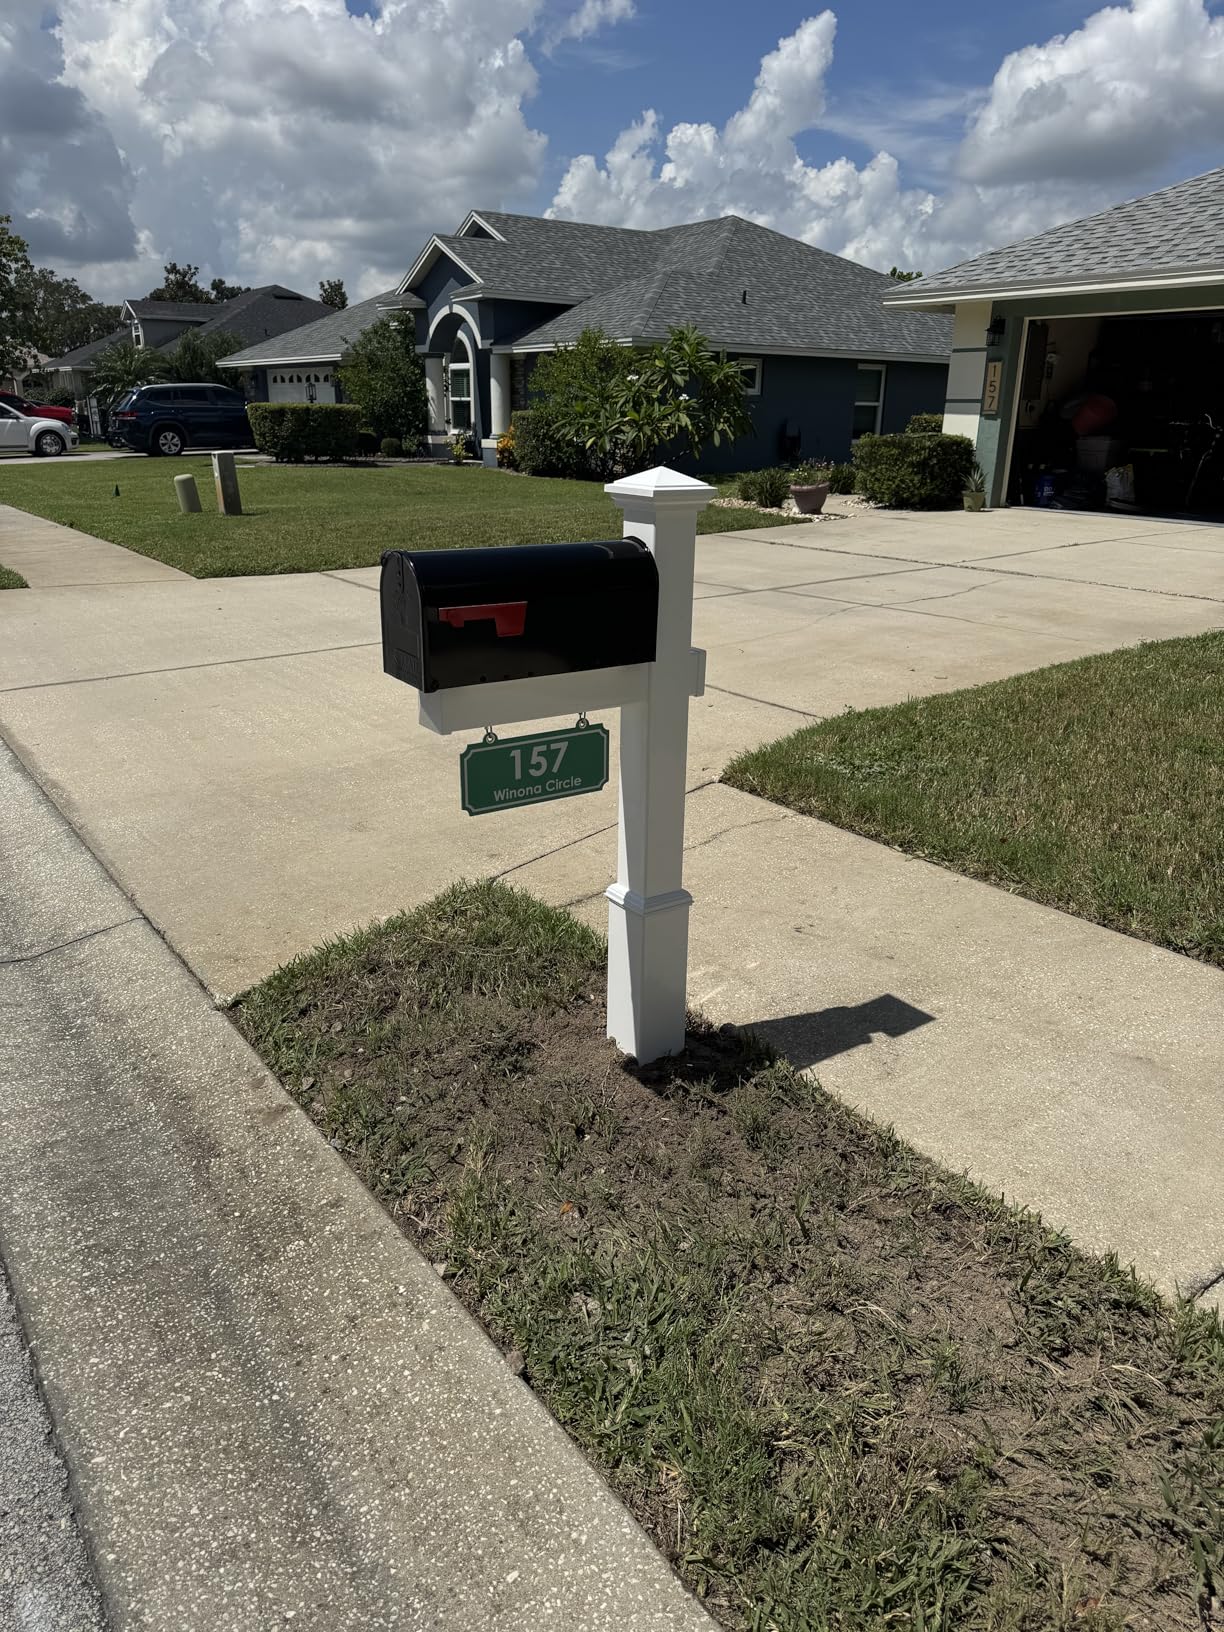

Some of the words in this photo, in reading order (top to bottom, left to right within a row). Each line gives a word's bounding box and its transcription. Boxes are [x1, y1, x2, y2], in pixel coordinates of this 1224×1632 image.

[987, 364, 997, 408] 157
[510, 741, 569, 780] 157
[493, 784, 542, 801] Winona
[545, 776, 582, 792] Circle
